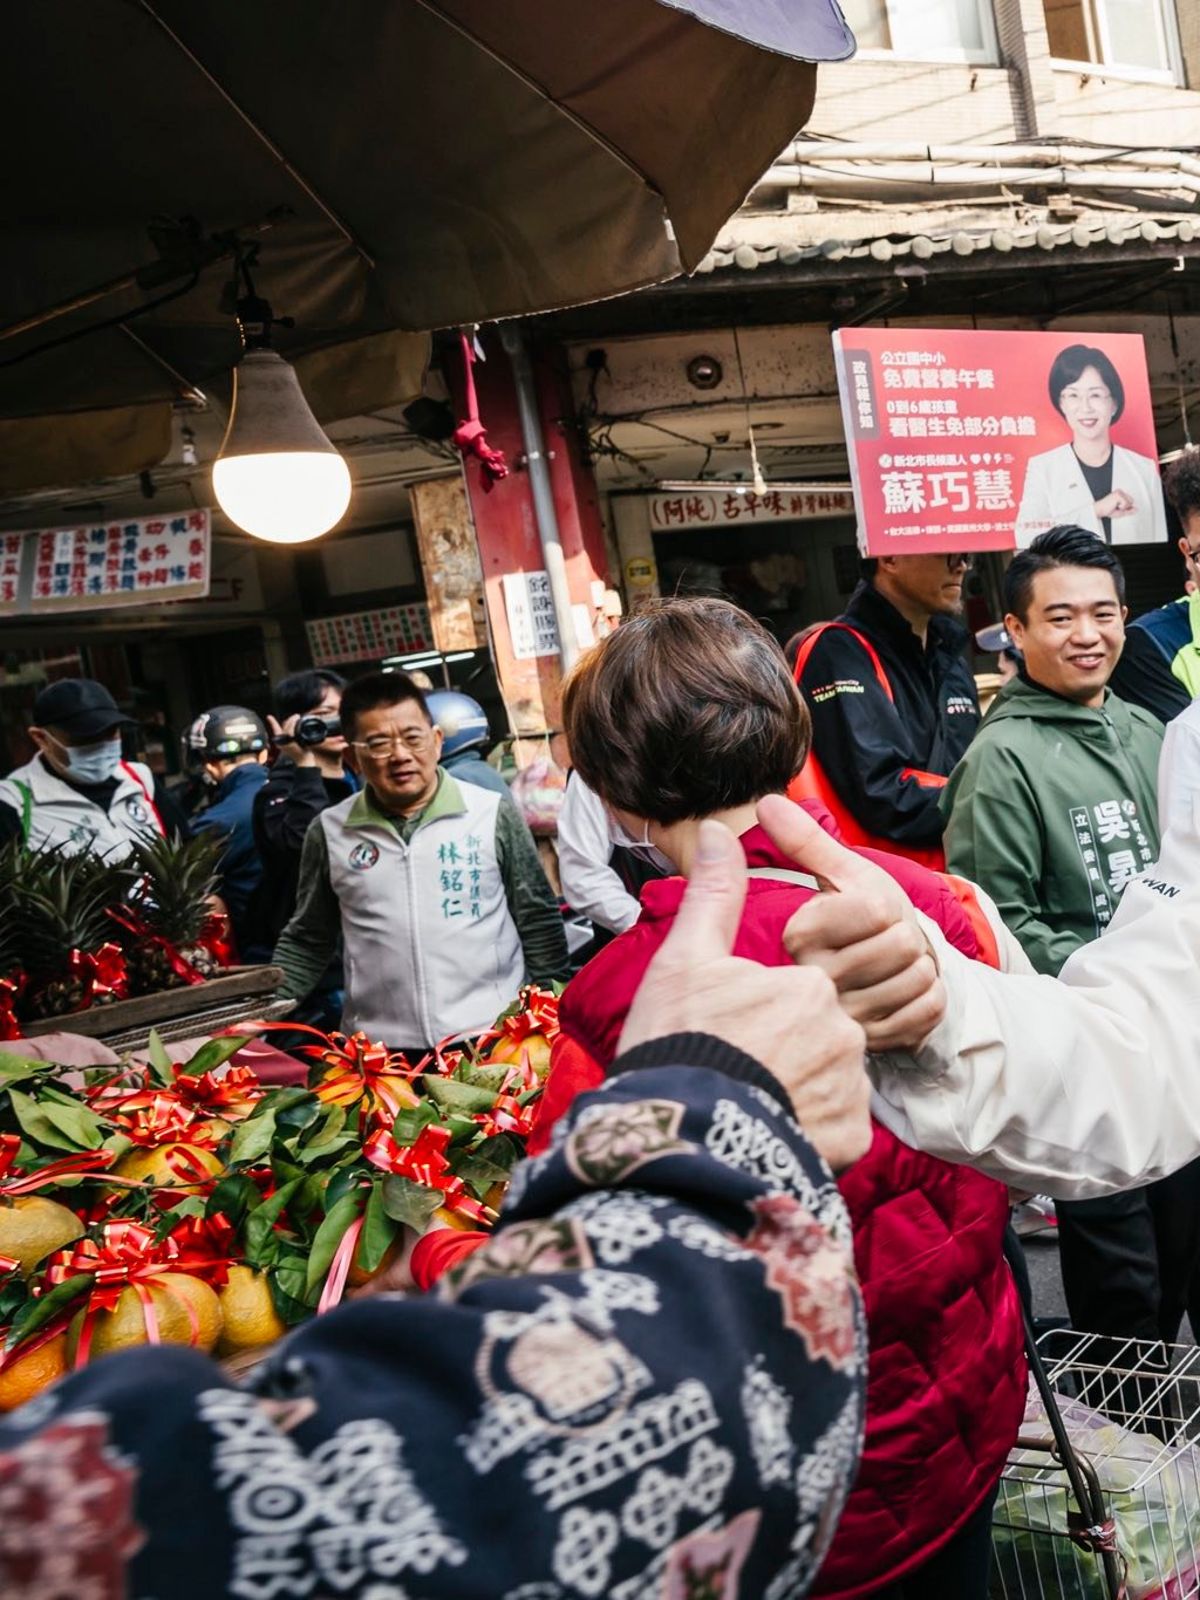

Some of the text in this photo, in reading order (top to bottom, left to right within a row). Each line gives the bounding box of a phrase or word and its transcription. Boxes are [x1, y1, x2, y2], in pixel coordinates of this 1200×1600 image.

[880, 351, 946, 366] 公立國中小
[882, 368, 995, 389] 免費營養午餐
[888, 416, 1037, 437] 看醫生免部分負擔
[880, 468, 1016, 514] 蘇巧慧
